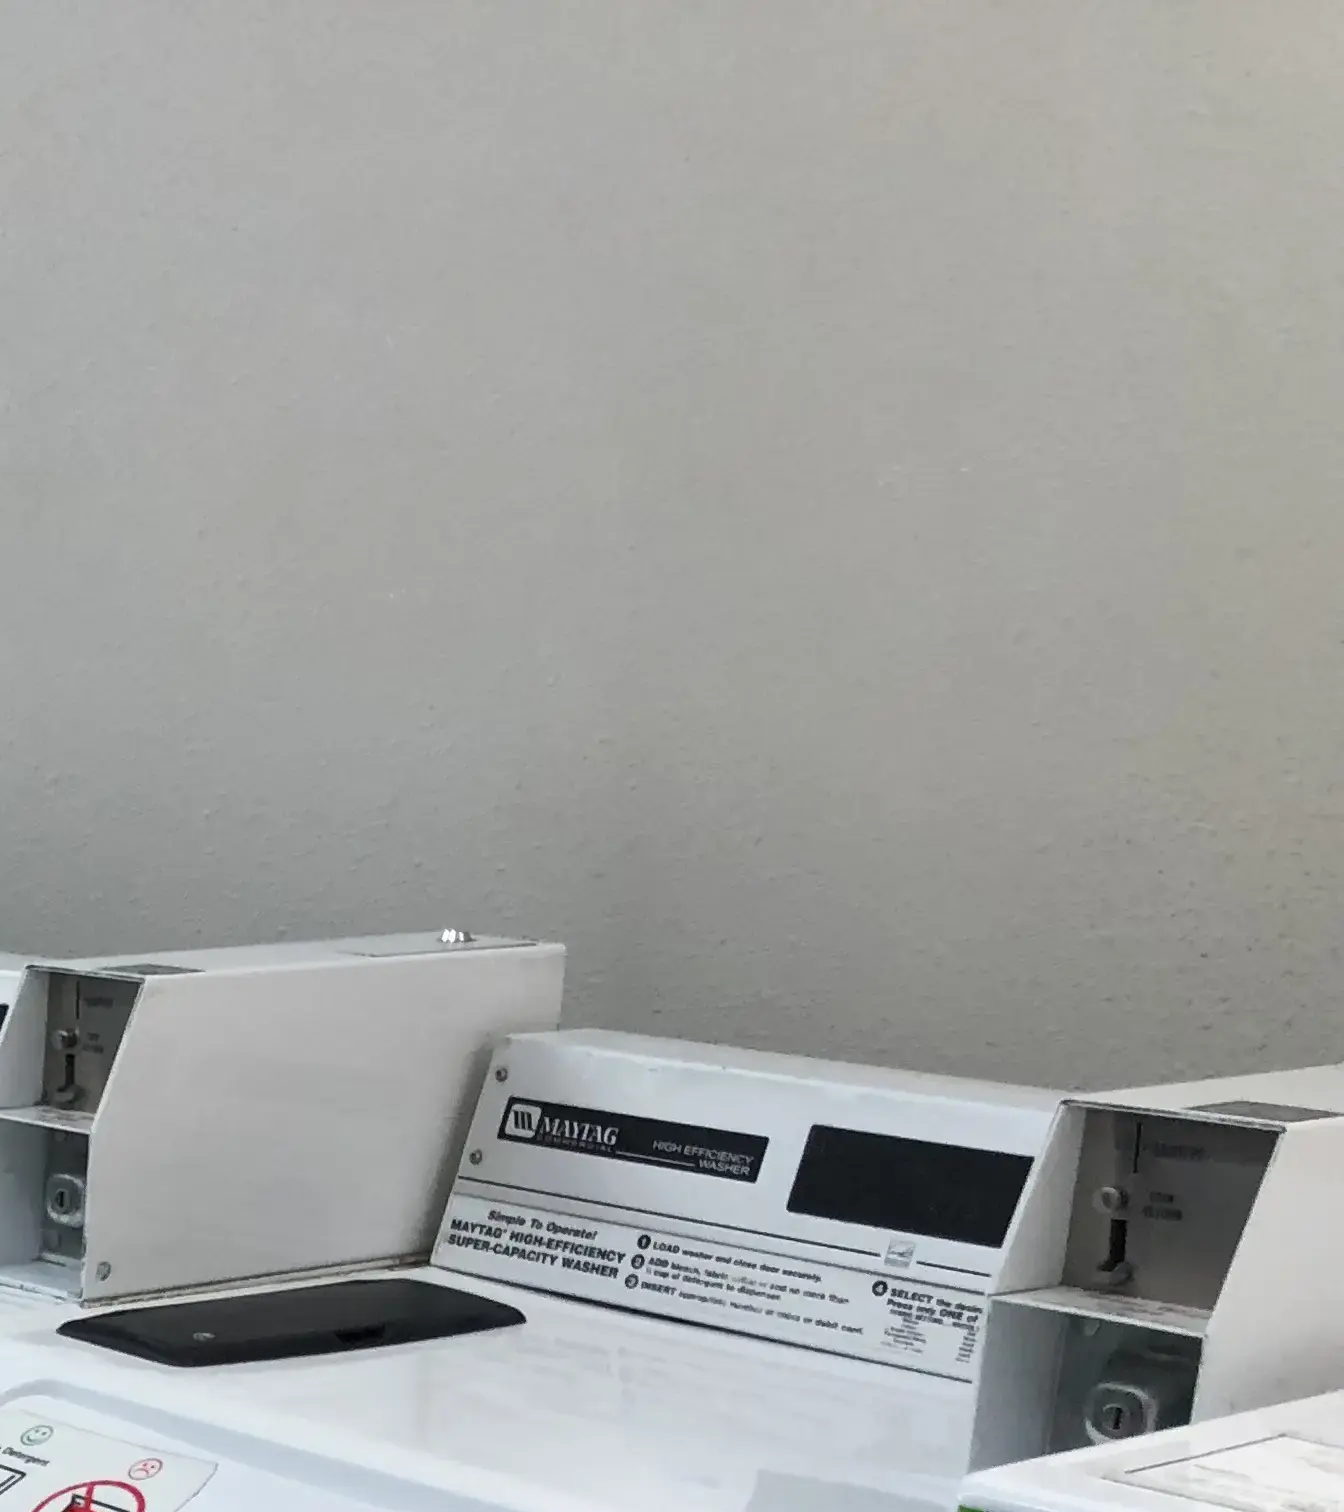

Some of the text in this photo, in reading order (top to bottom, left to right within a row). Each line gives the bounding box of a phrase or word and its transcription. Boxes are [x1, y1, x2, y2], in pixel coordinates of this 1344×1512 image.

[542, 1116, 619, 1146] MAYTAG
[653, 1140, 754, 1164] HIGH EFFICIENCY
[698, 1159, 751, 1176] WASHER
[488, 1209, 598, 1240] Simple To Operate!
[448, 1234, 619, 1279] SUPER-CAPACITY WASHER
[509, 1230, 626, 1263] HIGH-EFFICIENCY
[653, 1241, 680, 1254] LOAD
[890, 1288, 934, 1304] SELECT
